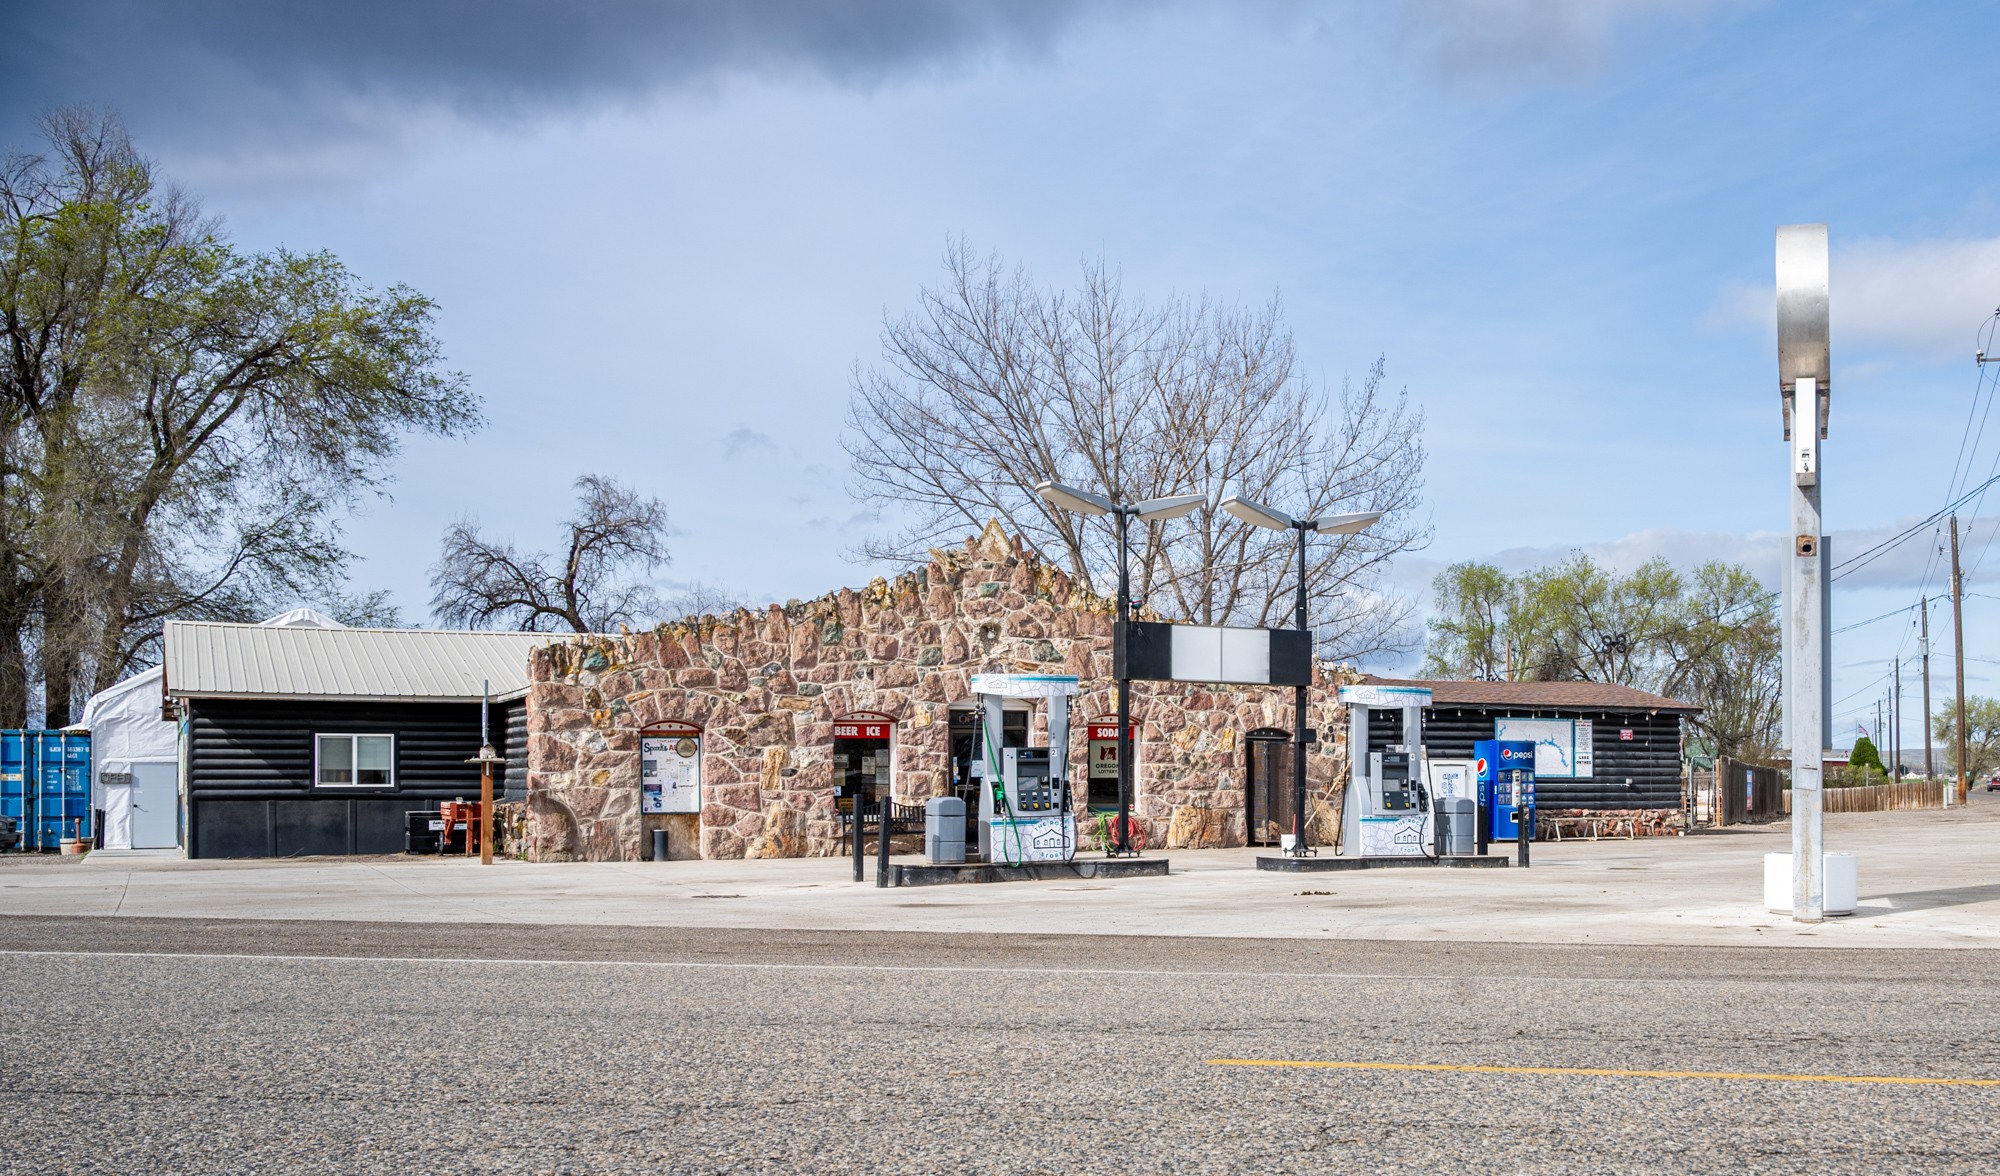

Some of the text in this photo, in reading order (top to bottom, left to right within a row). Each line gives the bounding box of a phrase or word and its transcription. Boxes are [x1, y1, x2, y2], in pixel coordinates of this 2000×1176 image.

[834, 726, 881, 737] BEER ICE
[1096, 727, 1119, 738] SODA
[1513, 751, 1533, 760] pepsi
[1034, 821, 1046, 831] THE
[1395, 820, 1405, 828] THE
